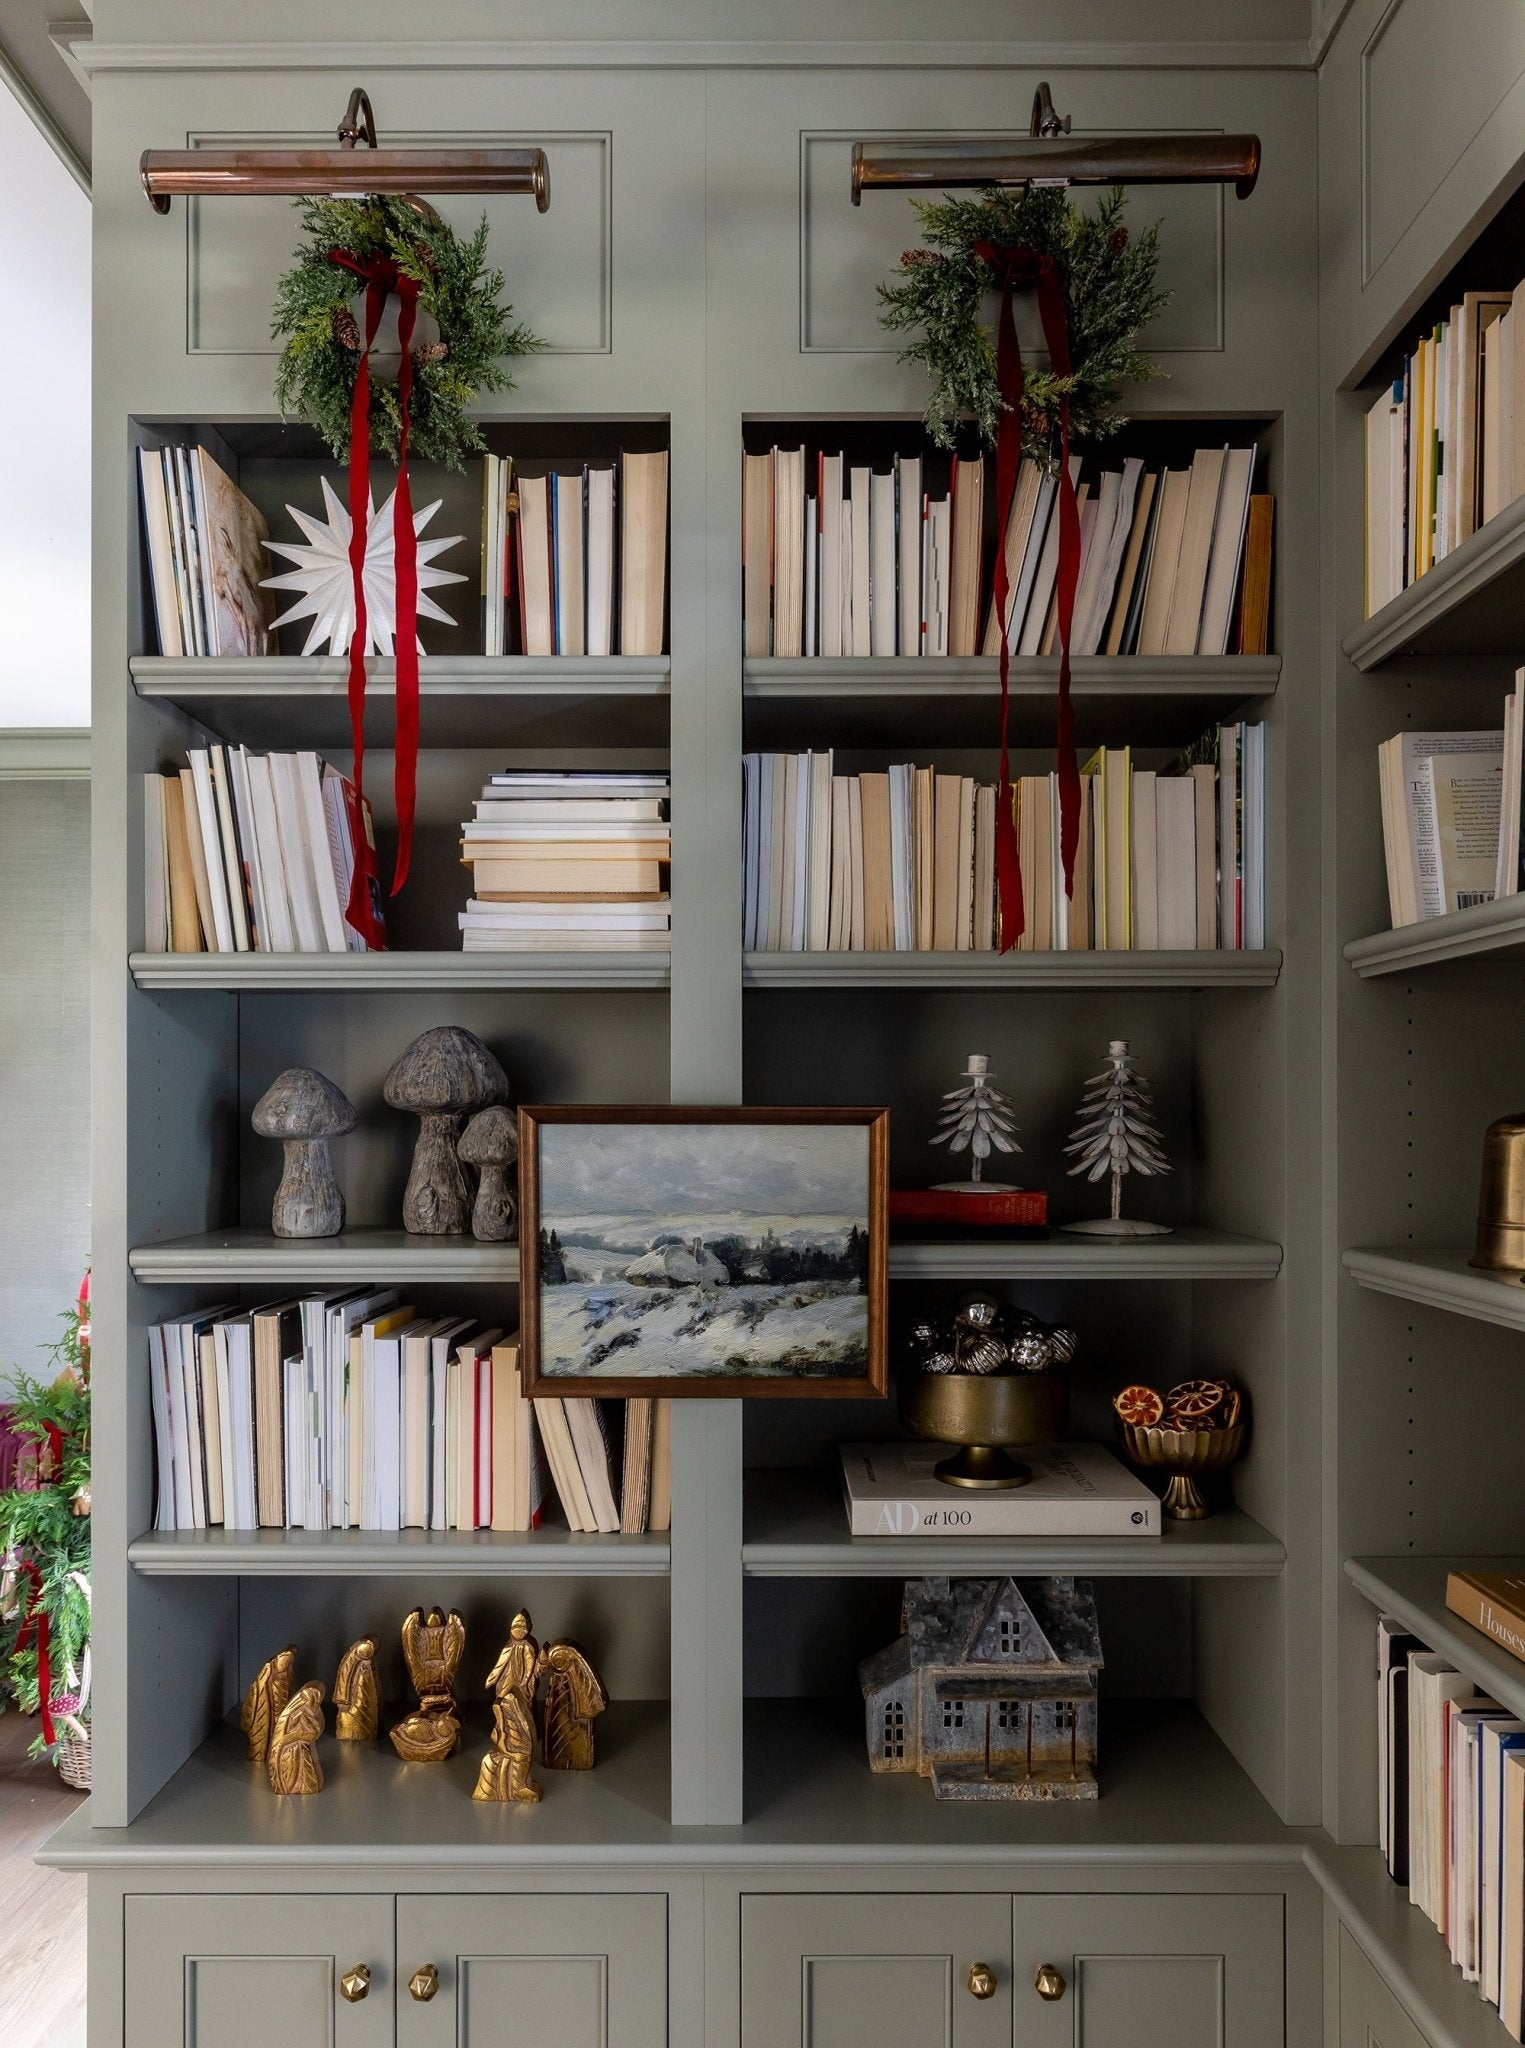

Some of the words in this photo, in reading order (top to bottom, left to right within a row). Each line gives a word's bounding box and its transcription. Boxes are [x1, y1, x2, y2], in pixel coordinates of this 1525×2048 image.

[875, 1502, 920, 1534] AD
[923, 1512, 939, 1526] at
[942, 1510, 972, 1526] 100
[1479, 1601, 1525, 1654] Houses
